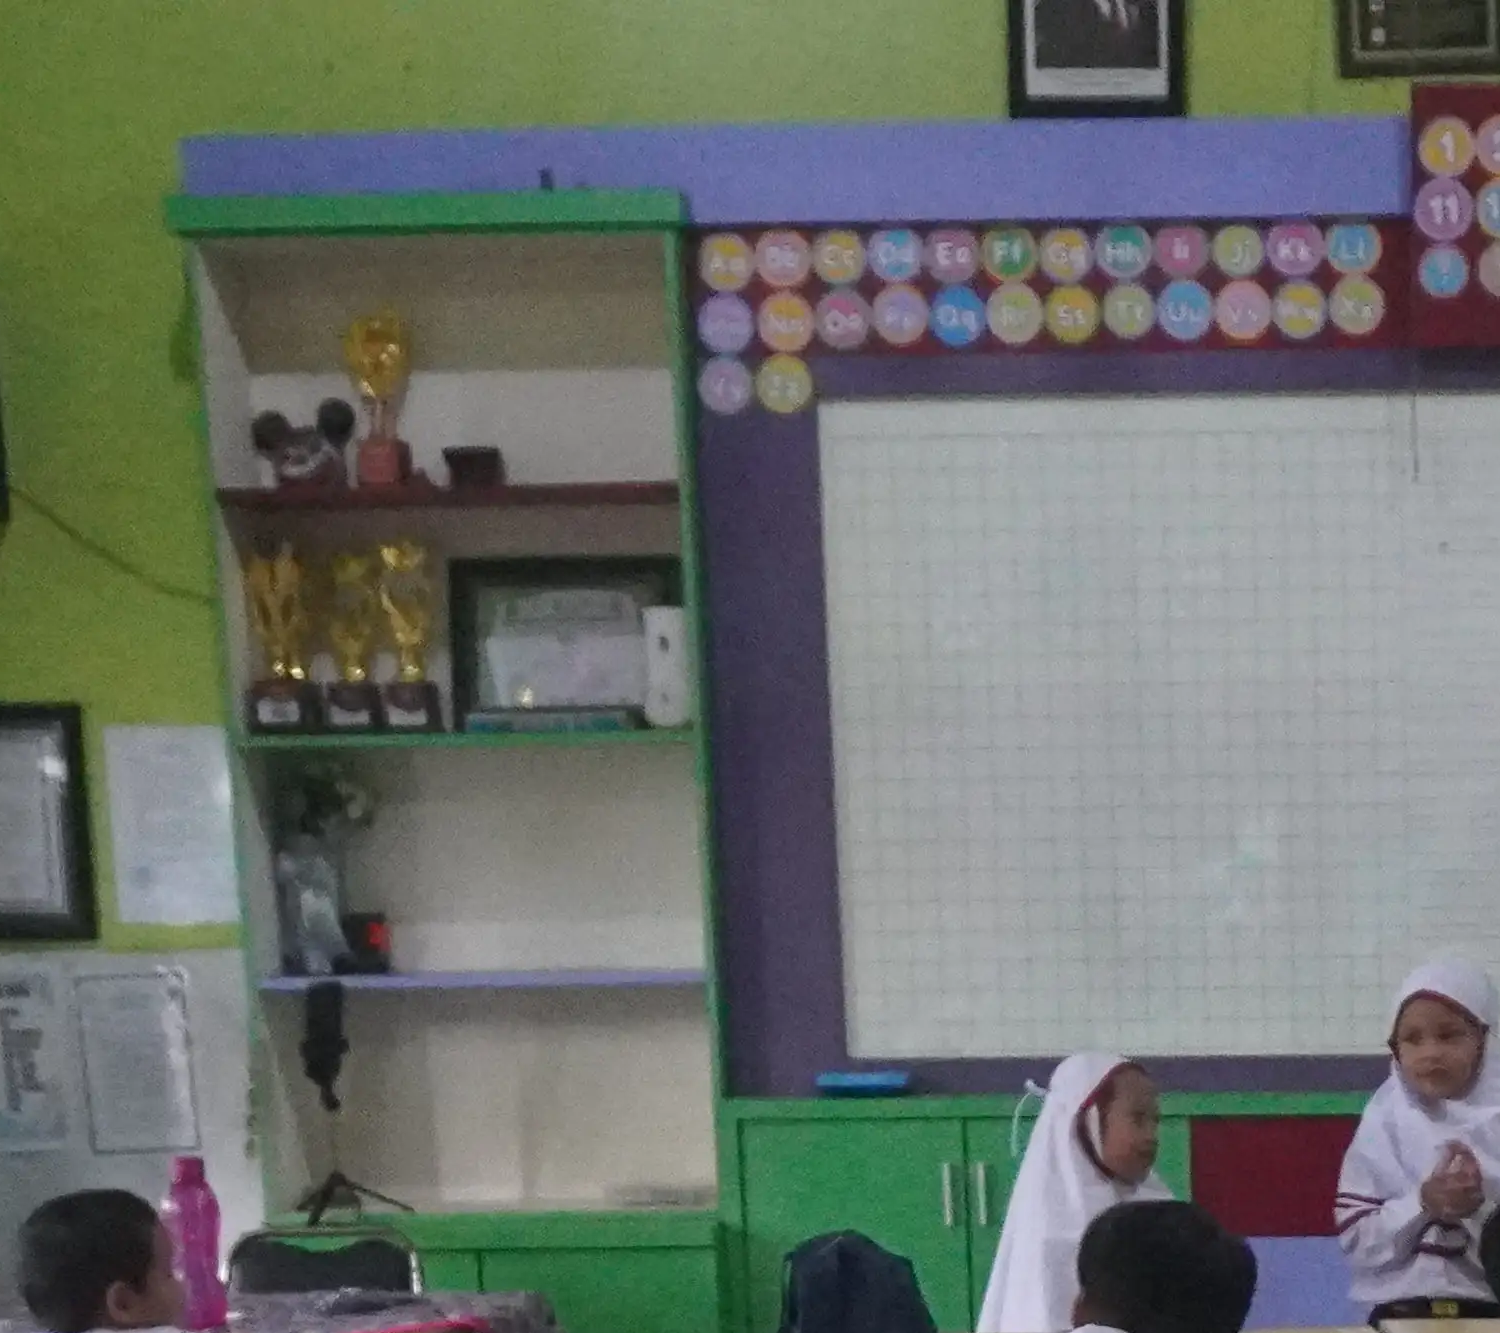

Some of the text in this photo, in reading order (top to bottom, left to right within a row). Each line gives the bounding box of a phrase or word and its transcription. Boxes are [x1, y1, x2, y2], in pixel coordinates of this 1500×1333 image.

[1440, 131, 1455, 163] 1
[1429, 193, 1460, 224] 11
[1105, 241, 1142, 264] Hh
[1278, 239, 1312, 262] Kk
